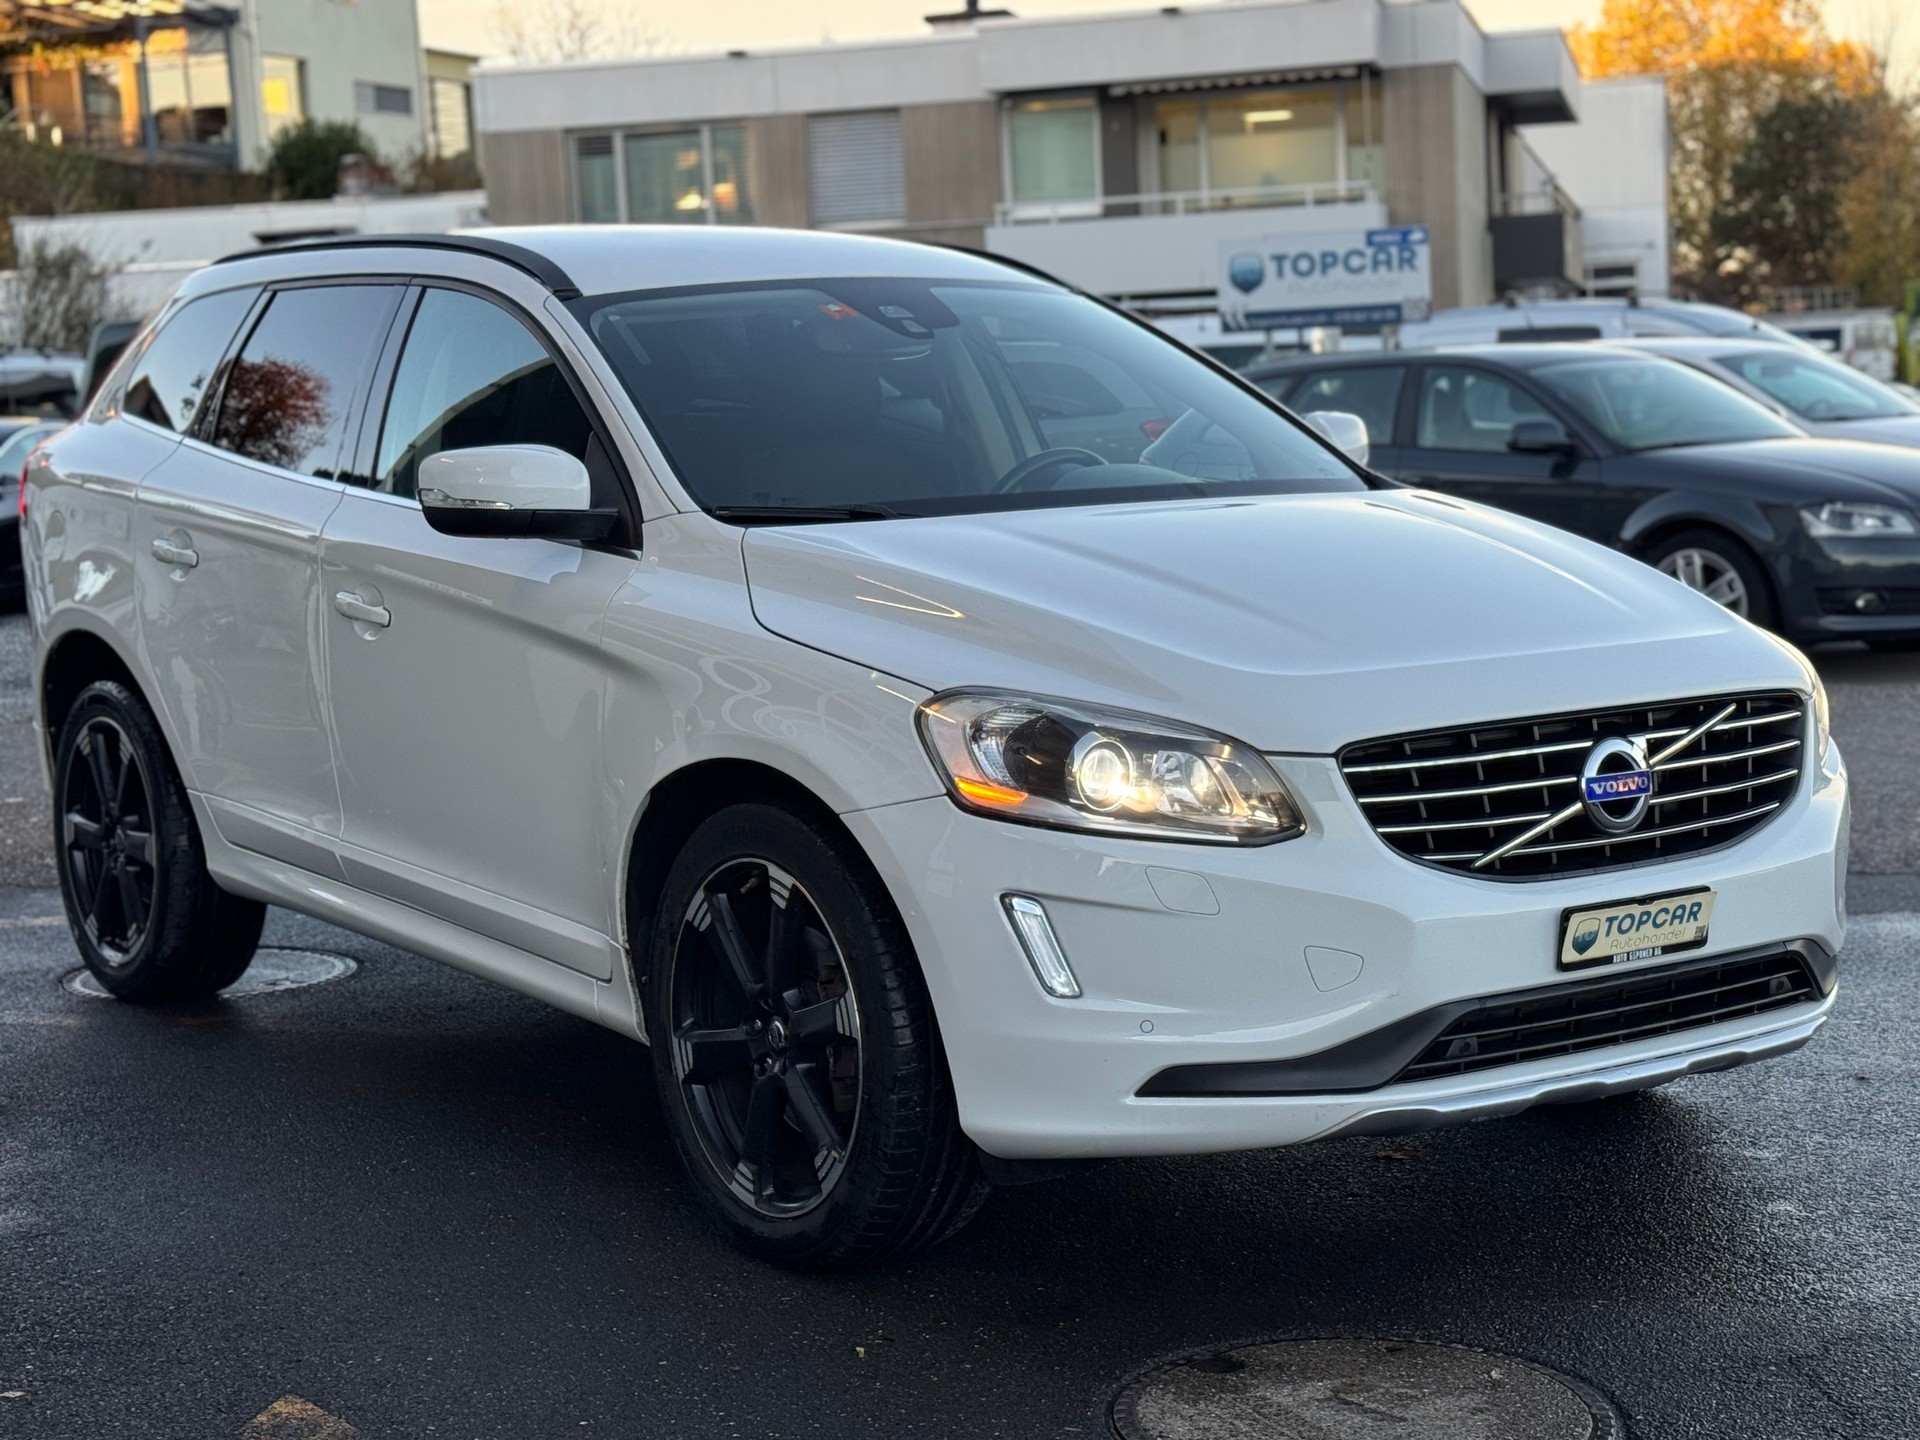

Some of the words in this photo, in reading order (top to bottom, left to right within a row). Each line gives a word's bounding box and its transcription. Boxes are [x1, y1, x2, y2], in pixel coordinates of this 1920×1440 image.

[1270, 247, 1418, 279] TOPCAR
[1589, 776, 1648, 795] VOLVO
[1604, 901, 1703, 938] TOPCAR
[1609, 927, 1686, 951] Autohandel
[1612, 952, 1628, 964] AUTO
